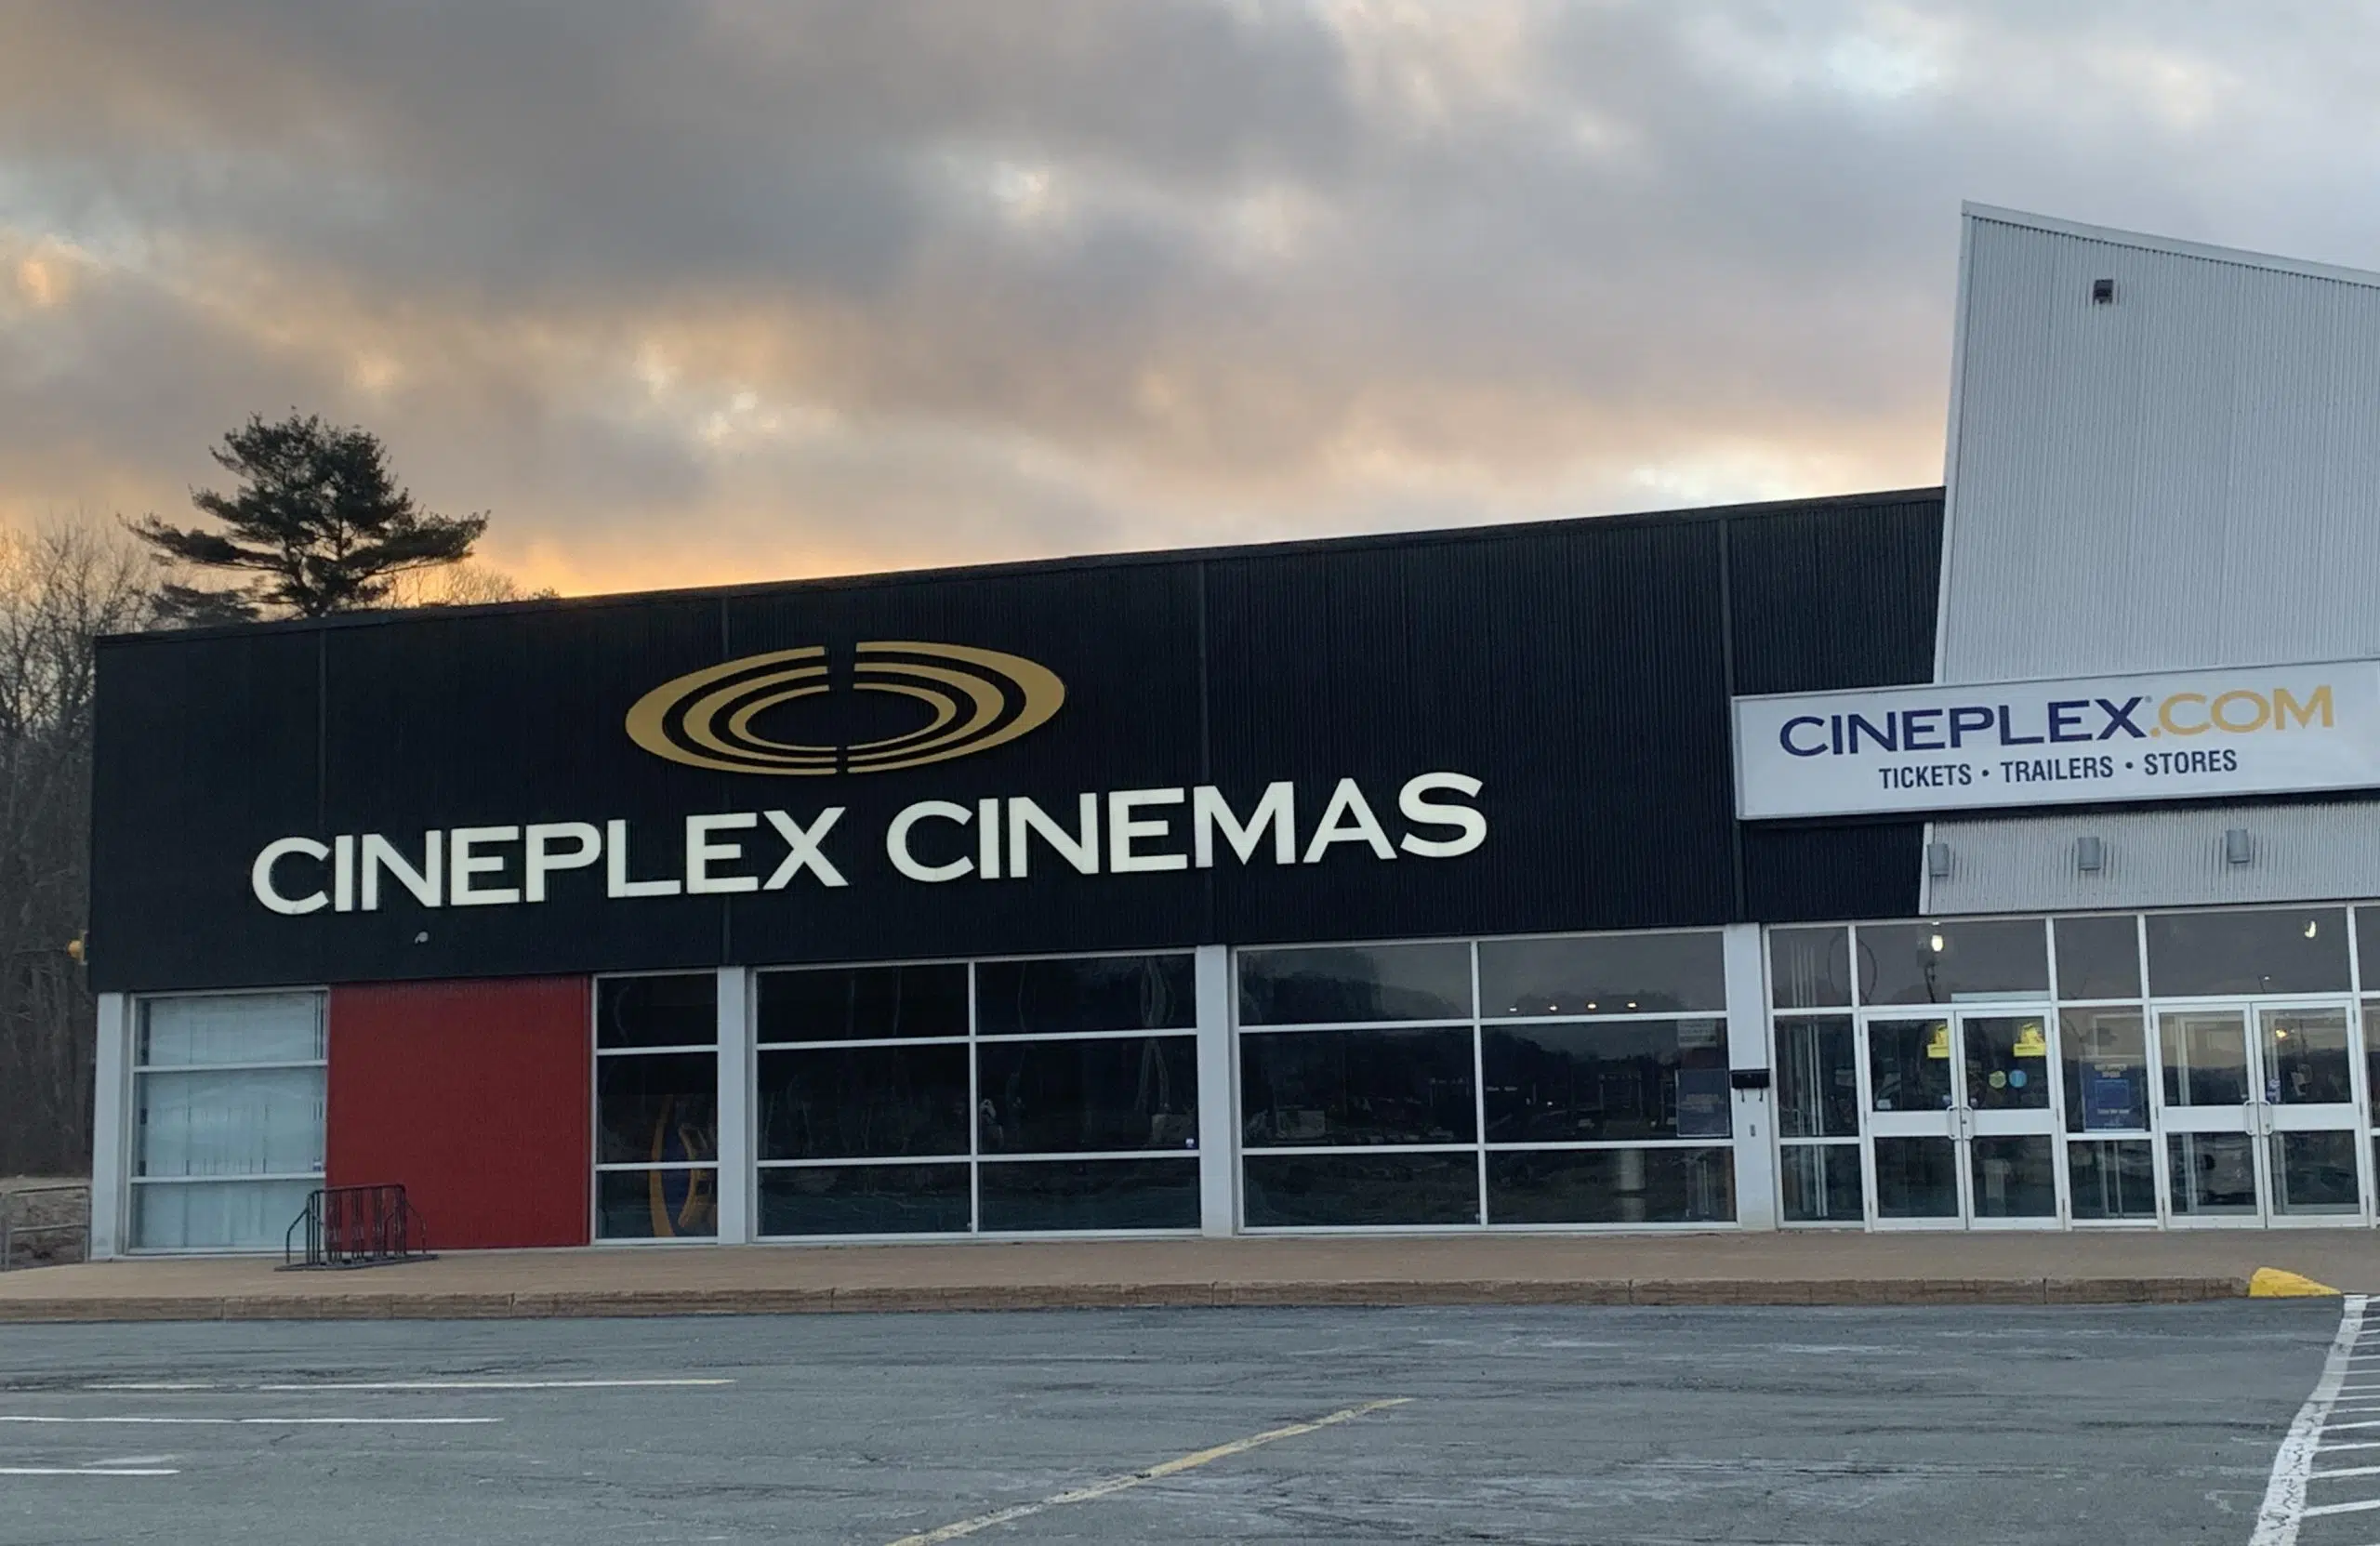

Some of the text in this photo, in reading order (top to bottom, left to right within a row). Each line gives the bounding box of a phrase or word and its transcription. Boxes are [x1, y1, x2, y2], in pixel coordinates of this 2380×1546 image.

[1878, 749, 2238, 789] TICKETS TRAILERS STORES
[251, 771, 1488, 916] CINEPLEX CINEMAS
